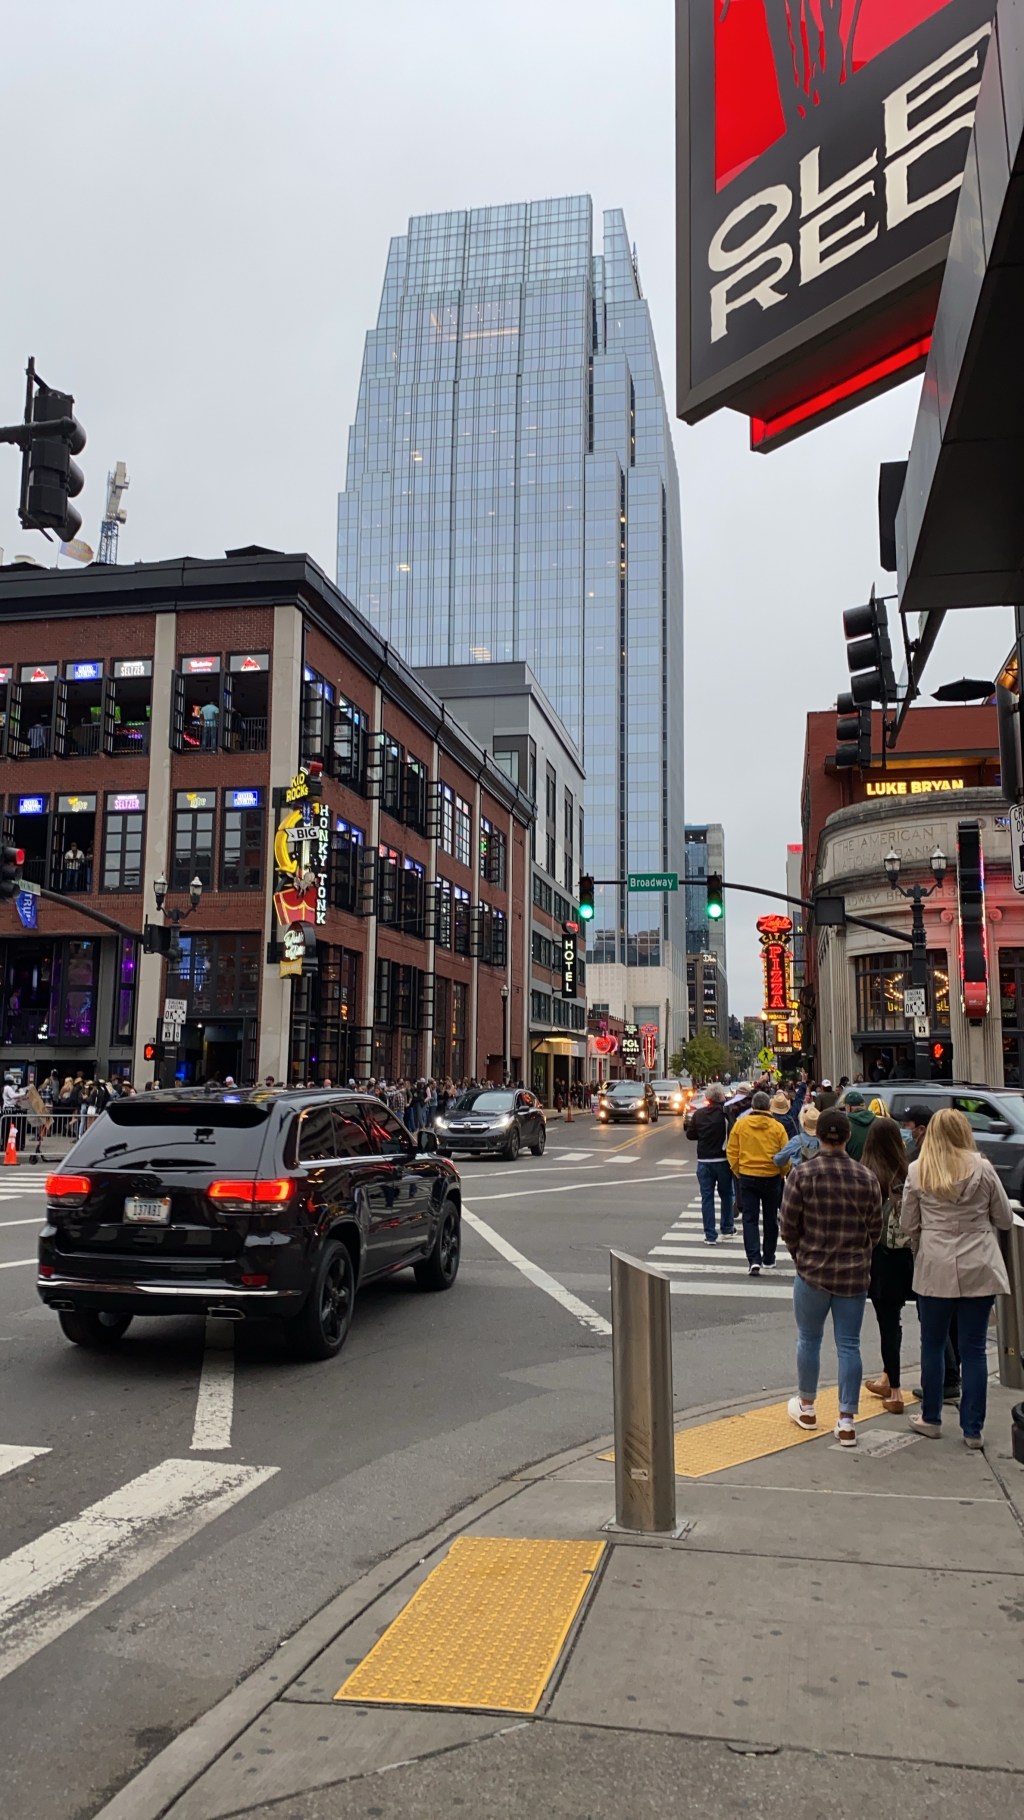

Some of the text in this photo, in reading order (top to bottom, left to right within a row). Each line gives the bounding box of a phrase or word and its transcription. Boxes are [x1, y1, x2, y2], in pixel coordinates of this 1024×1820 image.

[707, 21, 992, 271] OLE
[120, 665, 145, 676] SELTZER
[291, 772, 305, 788] KID
[866, 779, 964, 796] LUKE BRYAN
[114, 799, 140, 810] SELTZER
[296, 828, 317, 839] BIG
[838, 827, 934, 852] THE AMERICAN
[895, 844, 936, 858] BANK
[316, 804, 329, 925] HONKY TONK
[630, 877, 673, 889] Broadway
[761, 932, 787, 943] CITY
[564, 940, 574, 992] HOTEL
[769, 945, 785, 1008] PIZZA
[165, 1010, 174, 1020] OK
[905, 1003, 914, 1014] OK
[622, 1039, 640, 1048] FGL
